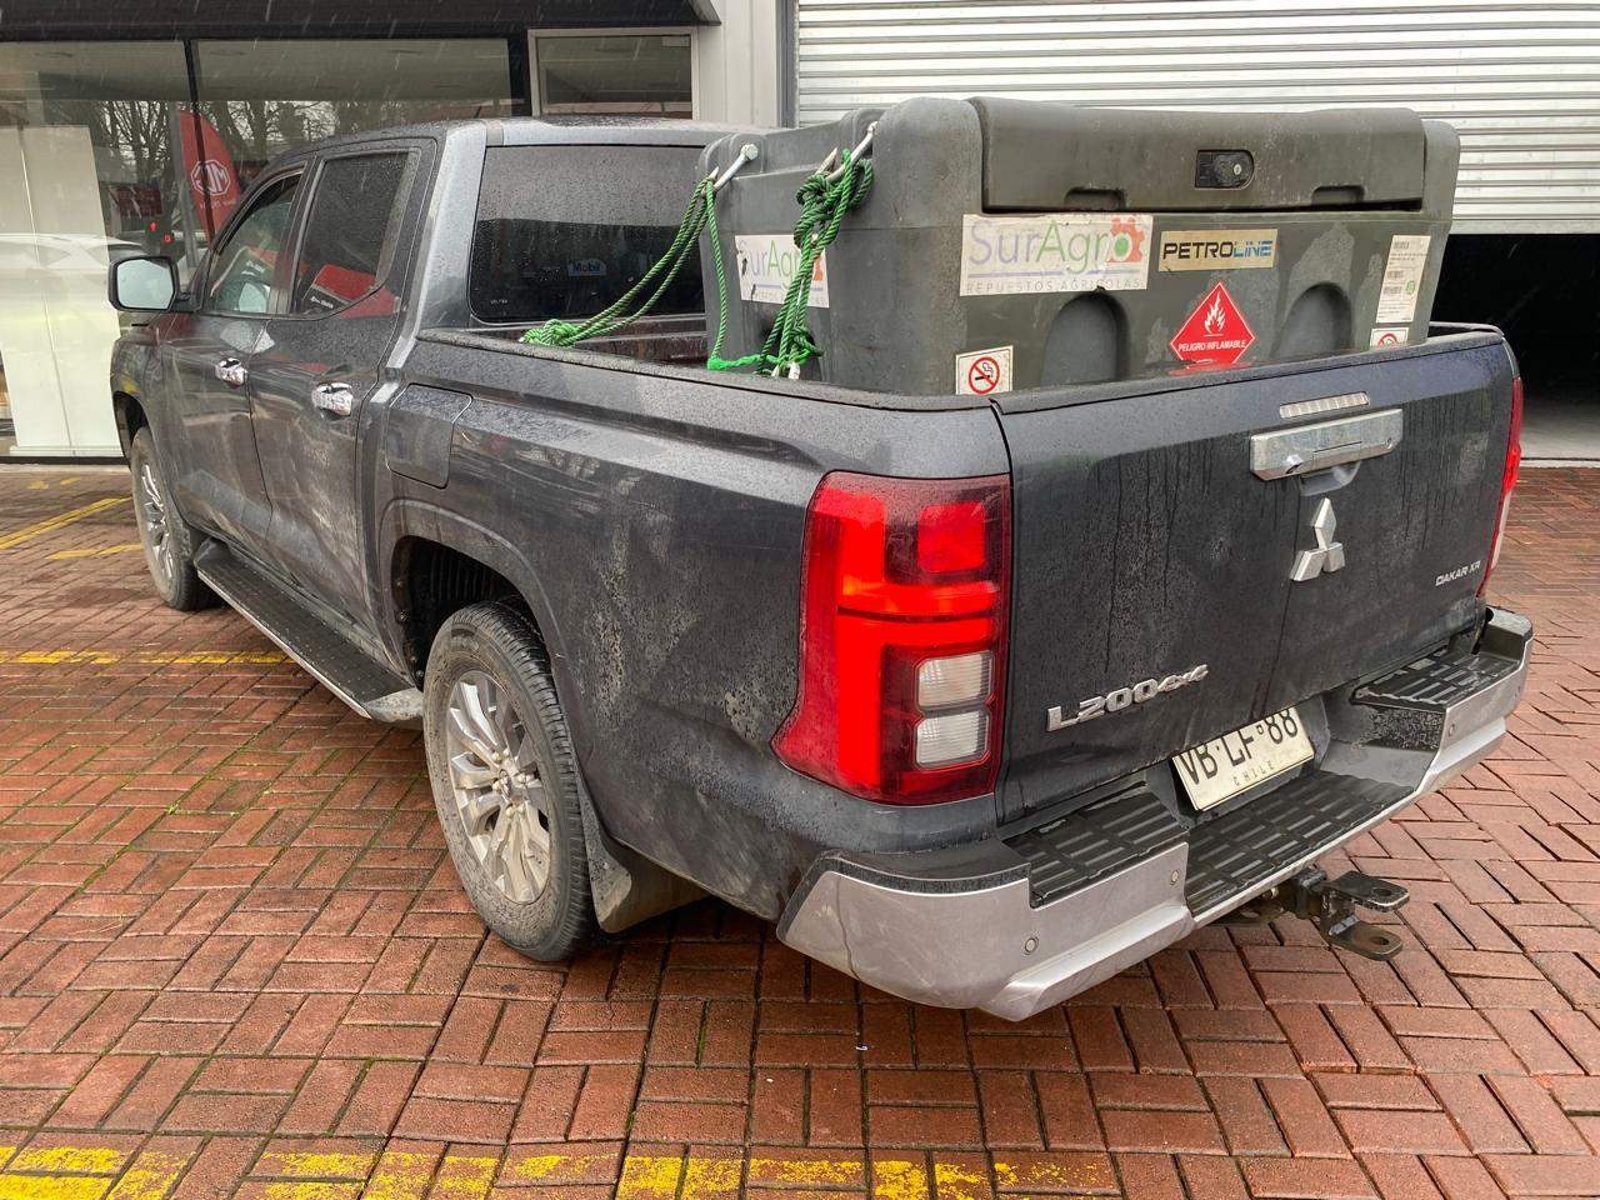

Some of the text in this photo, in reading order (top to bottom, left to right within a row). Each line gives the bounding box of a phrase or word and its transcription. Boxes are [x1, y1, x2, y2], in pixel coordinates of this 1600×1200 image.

[969, 219, 1136, 274] SurAgro
[1163, 240, 1273, 260] PETROLINE
[1178, 340, 1247, 352] PELIGRO INFLAMABLE
[1435, 566, 1469, 586] DAKAR
[1047, 678, 1159, 732] L200
[1232, 759, 1275, 787] CHILE
